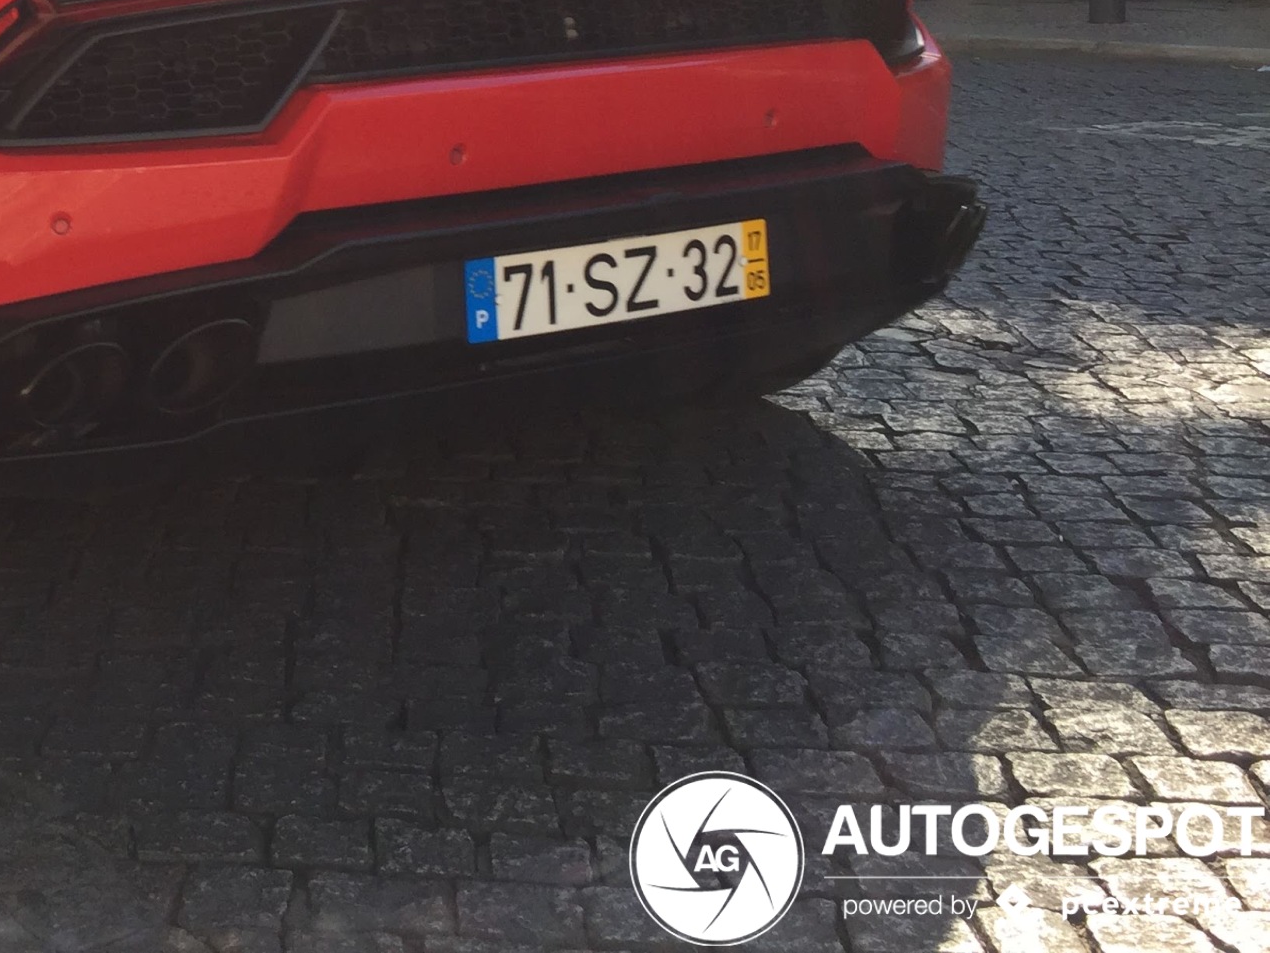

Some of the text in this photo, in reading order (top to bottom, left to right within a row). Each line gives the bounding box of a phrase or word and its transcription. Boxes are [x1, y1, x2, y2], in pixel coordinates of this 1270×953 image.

[747, 230, 762, 252] 17
[747, 270, 766, 292] 05
[475, 310, 490, 329] P
